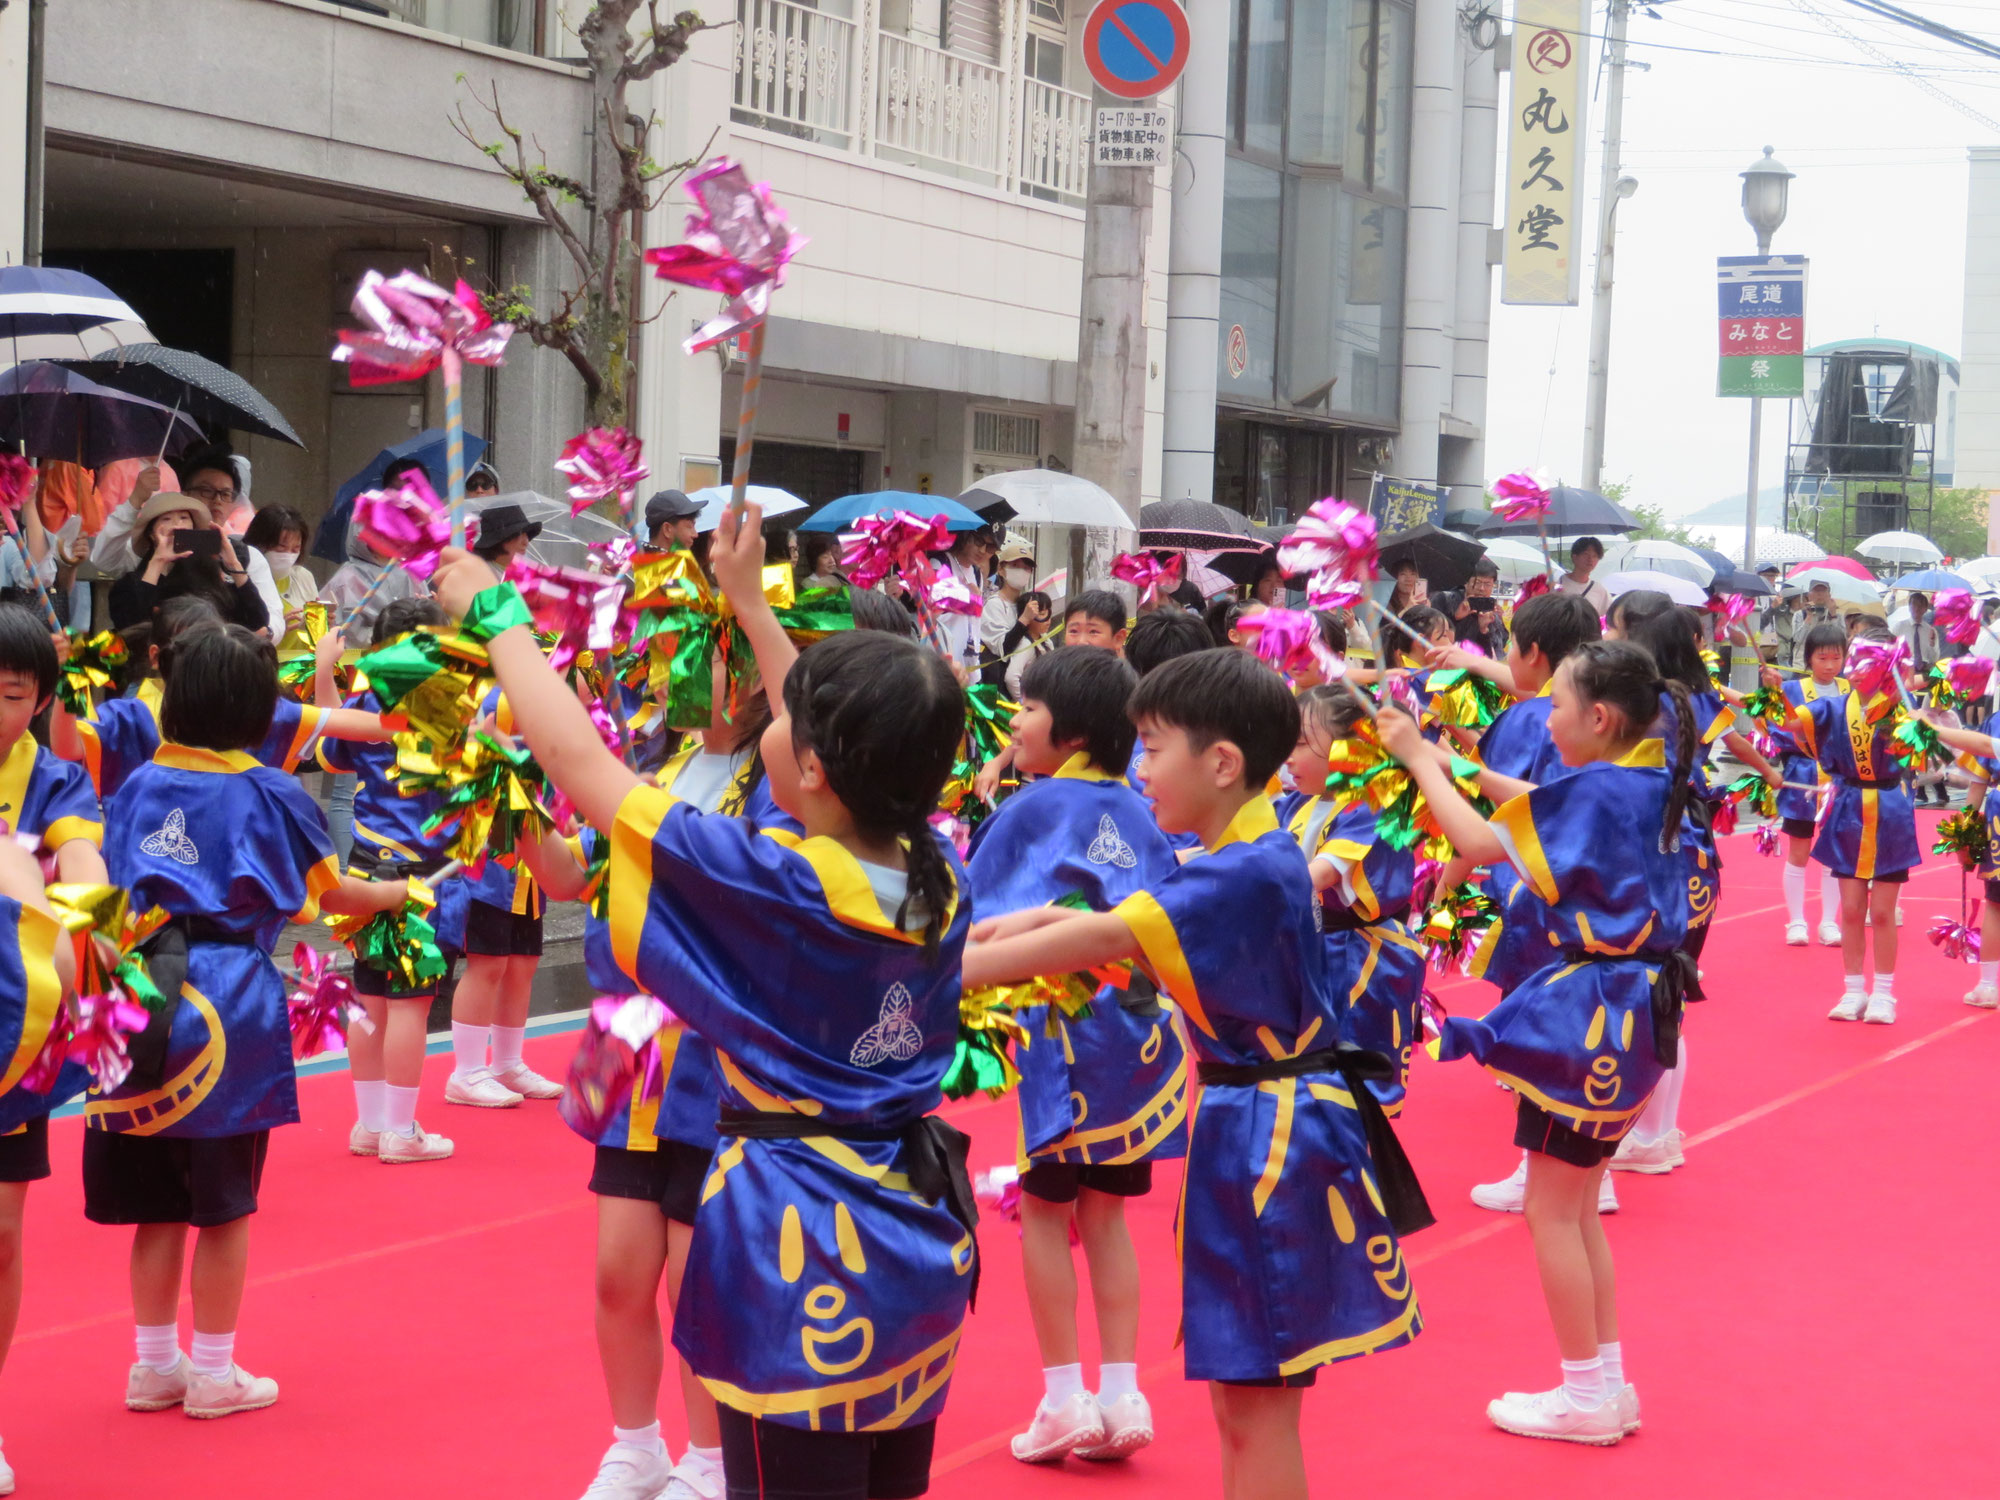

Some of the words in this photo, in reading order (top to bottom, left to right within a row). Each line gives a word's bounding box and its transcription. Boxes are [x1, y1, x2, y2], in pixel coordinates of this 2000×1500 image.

[1099, 129, 1165, 144] 貨物集配中の
[1099, 147, 1161, 162] 貨物車を除く
[1518, 87, 1569, 251] 丸久堂
[1739, 284, 1783, 304] 尾道
[1729, 322, 1793, 341] みなと
[1751, 360, 1770, 378] 祭
[1388, 485, 1437, 502] KaijuLemon
